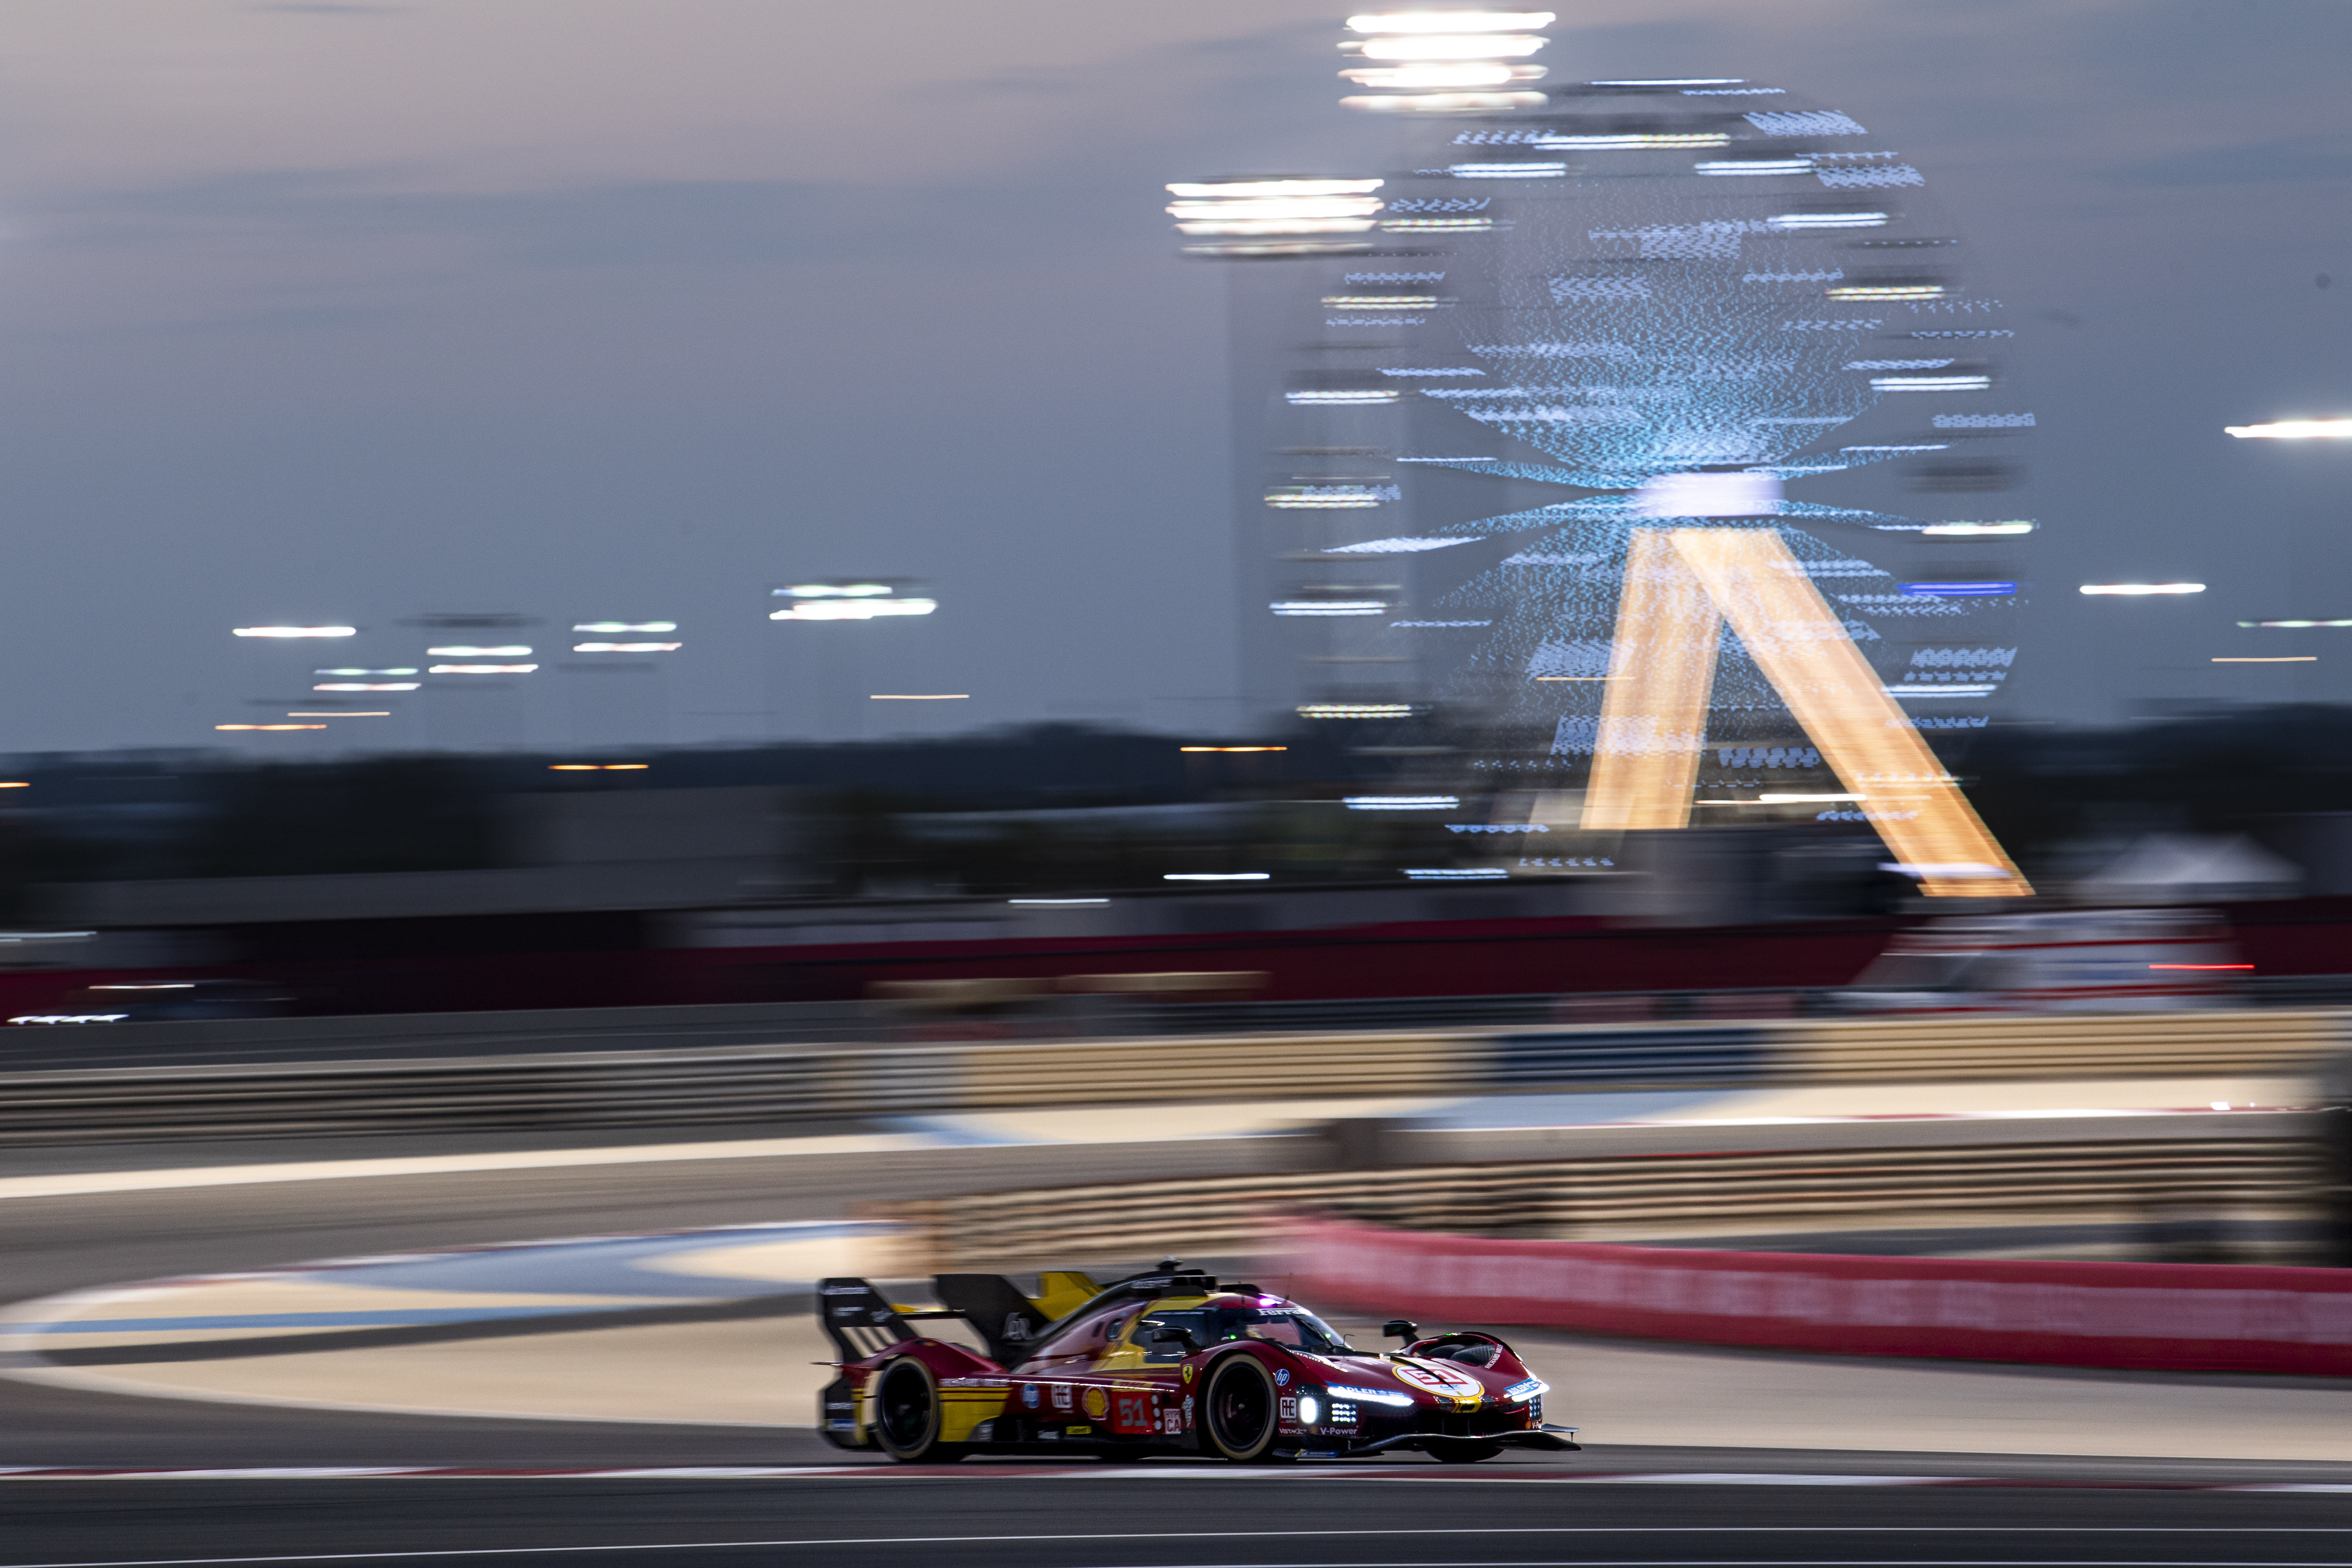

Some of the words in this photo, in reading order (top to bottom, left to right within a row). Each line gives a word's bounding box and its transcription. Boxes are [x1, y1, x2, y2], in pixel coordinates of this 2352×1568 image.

[1485, 1353, 1500, 1369] RICHARD
[1277, 1369, 1288, 1385] hp
[1400, 1369, 1469, 1385] 51
[1119, 1399, 1147, 1426] 51
